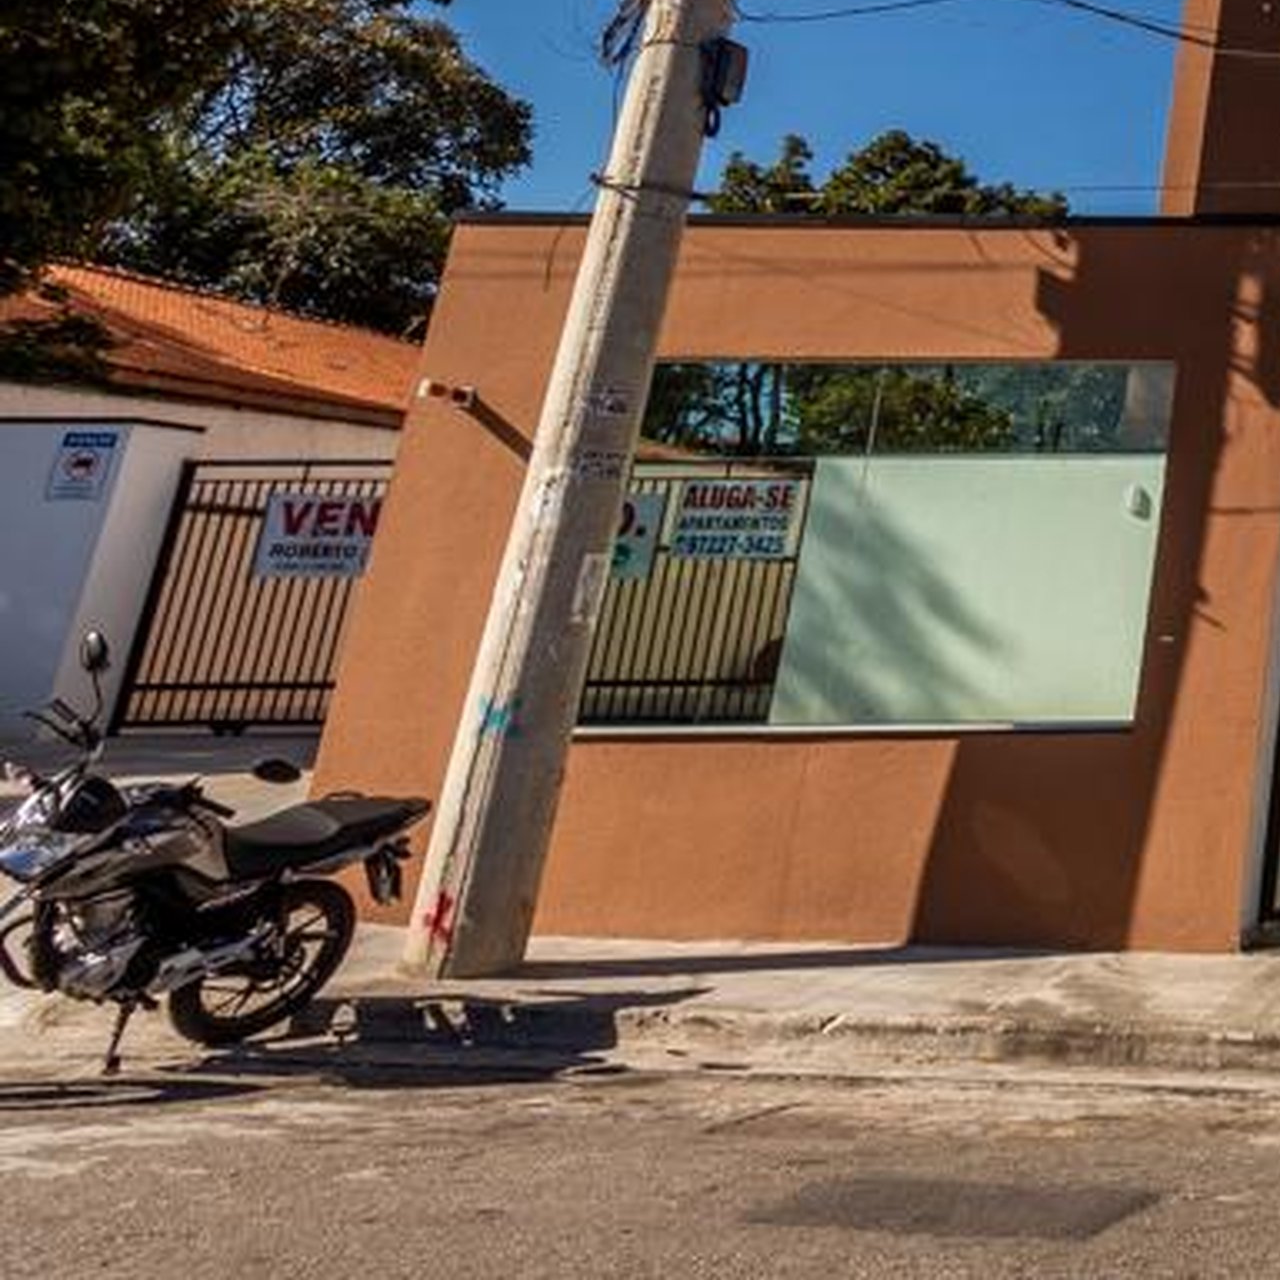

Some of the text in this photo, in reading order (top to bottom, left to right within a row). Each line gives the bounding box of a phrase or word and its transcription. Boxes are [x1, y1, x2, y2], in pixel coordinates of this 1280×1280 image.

[683, 484, 793, 510] ALUGA-SE
[282, 501, 382, 537] VEN
[679, 515, 788, 531] APARTAMENTOS
[268, 543, 358, 559] ROBERTO
